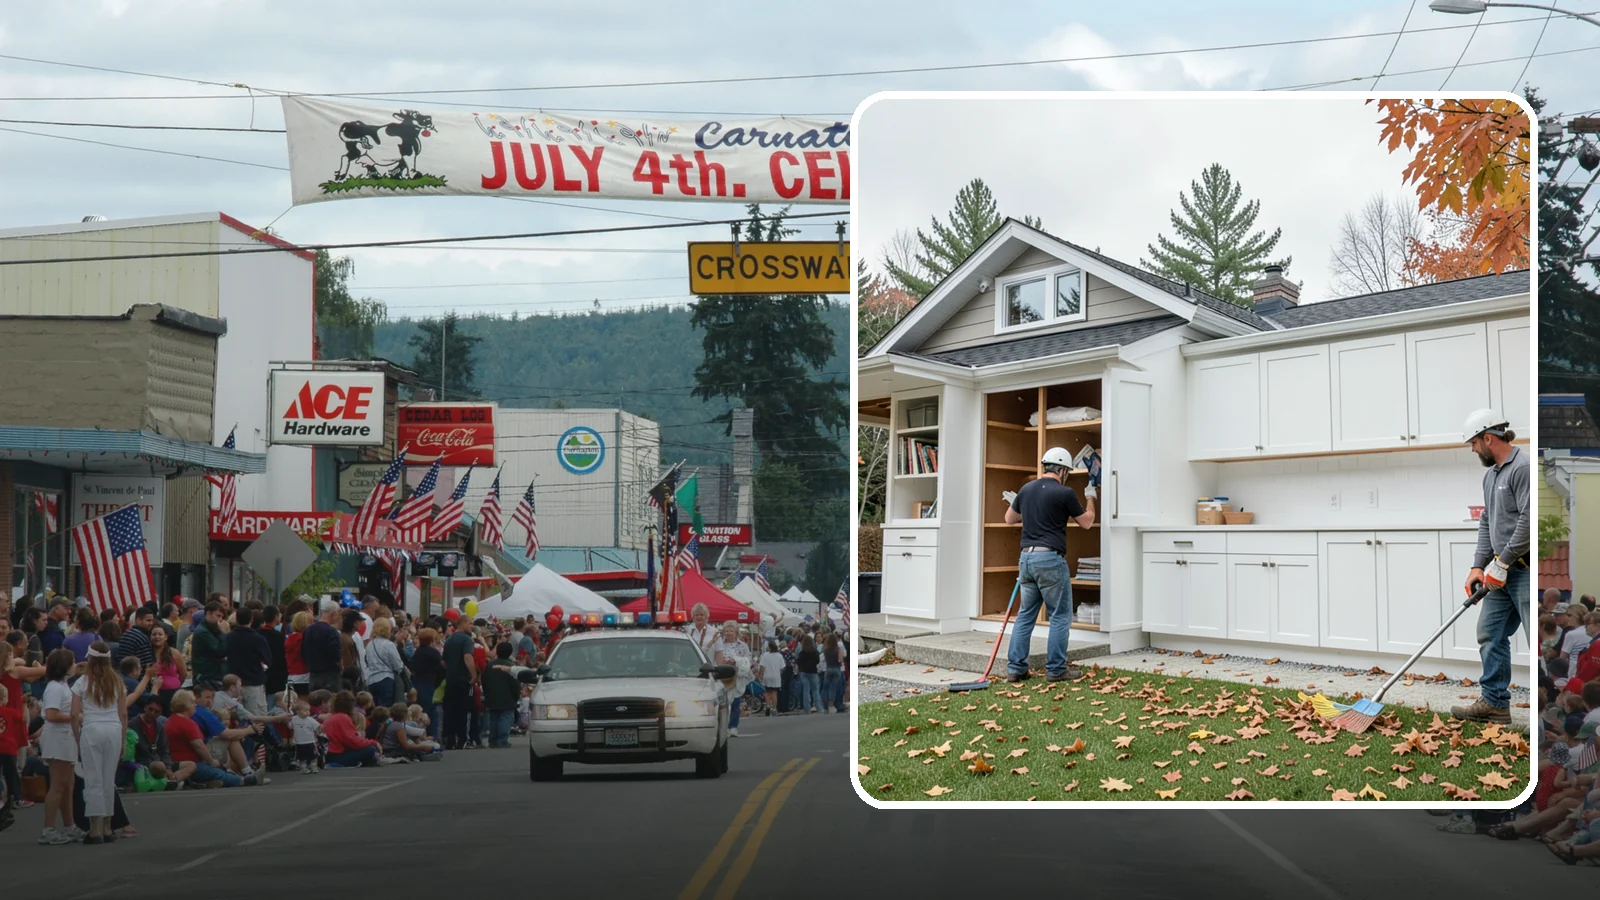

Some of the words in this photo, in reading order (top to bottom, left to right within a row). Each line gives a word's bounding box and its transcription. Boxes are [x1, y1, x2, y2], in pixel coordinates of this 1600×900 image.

[481, 140, 605, 192] JULY
[632, 150, 747, 198] 4th.
[697, 254, 850, 280] CROSSWA
[282, 380, 373, 420] ACE
[405, 409, 453, 422] CEDAR
[461, 409, 485, 422] LOG
[283, 421, 371, 436] Hardware
[416, 428, 477, 447] Coca-Cola
[353, 467, 386, 481] Simpl
[96, 485, 124, 494] Vincent
[126, 485, 136, 494] de
[138, 485, 155, 495] Paul
[688, 526, 741, 535] CRNATION
[699, 535, 730, 543] GLASS
